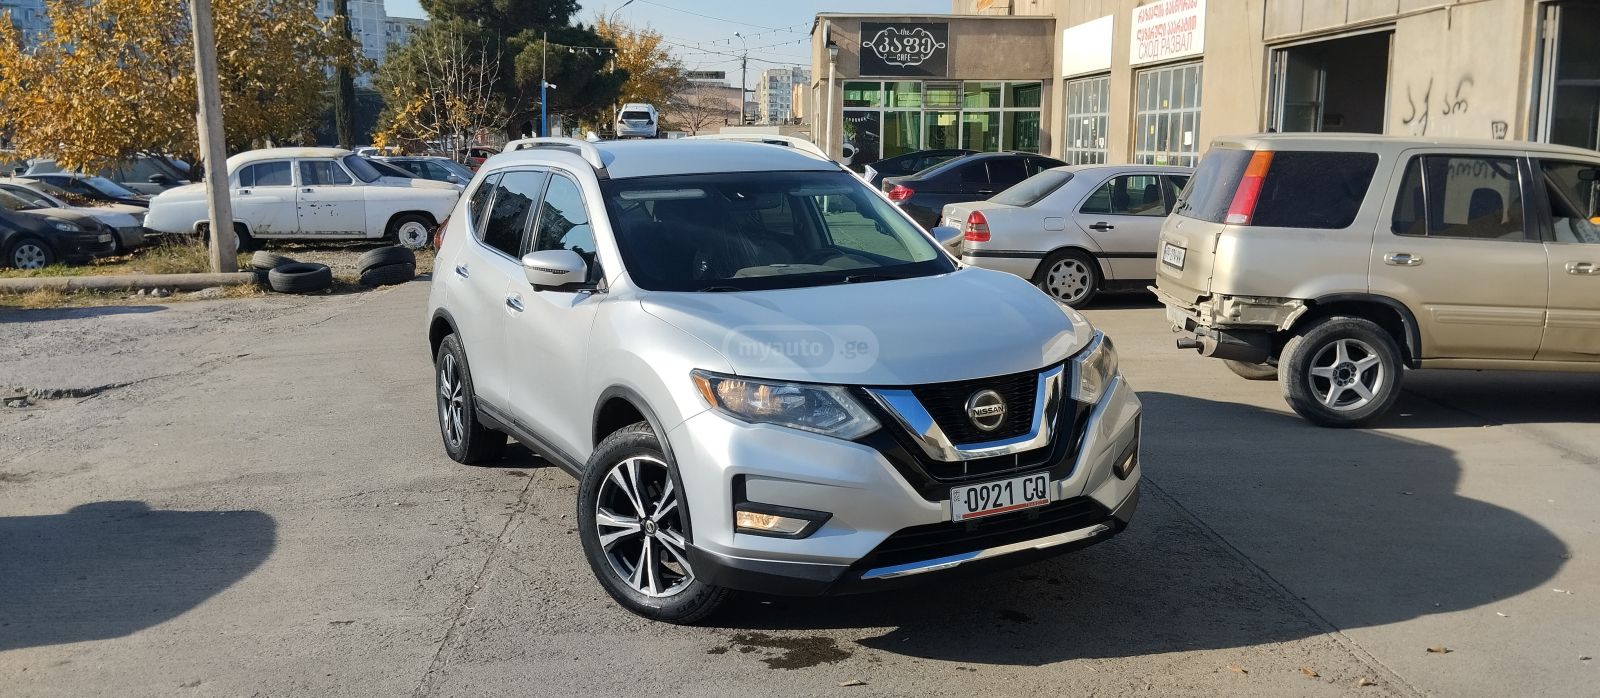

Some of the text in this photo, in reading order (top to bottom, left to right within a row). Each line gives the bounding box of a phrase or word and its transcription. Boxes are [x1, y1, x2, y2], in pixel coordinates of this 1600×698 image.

[900, 28, 911, 36] the
[879, 37, 931, 53] კაფე
[1138, 32, 1193, 60] СХОД РАЗВАЛ
[973, 405, 1004, 416] NISSAN
[967, 481, 1014, 512] 0921
[1023, 475, 1047, 501] CQ
